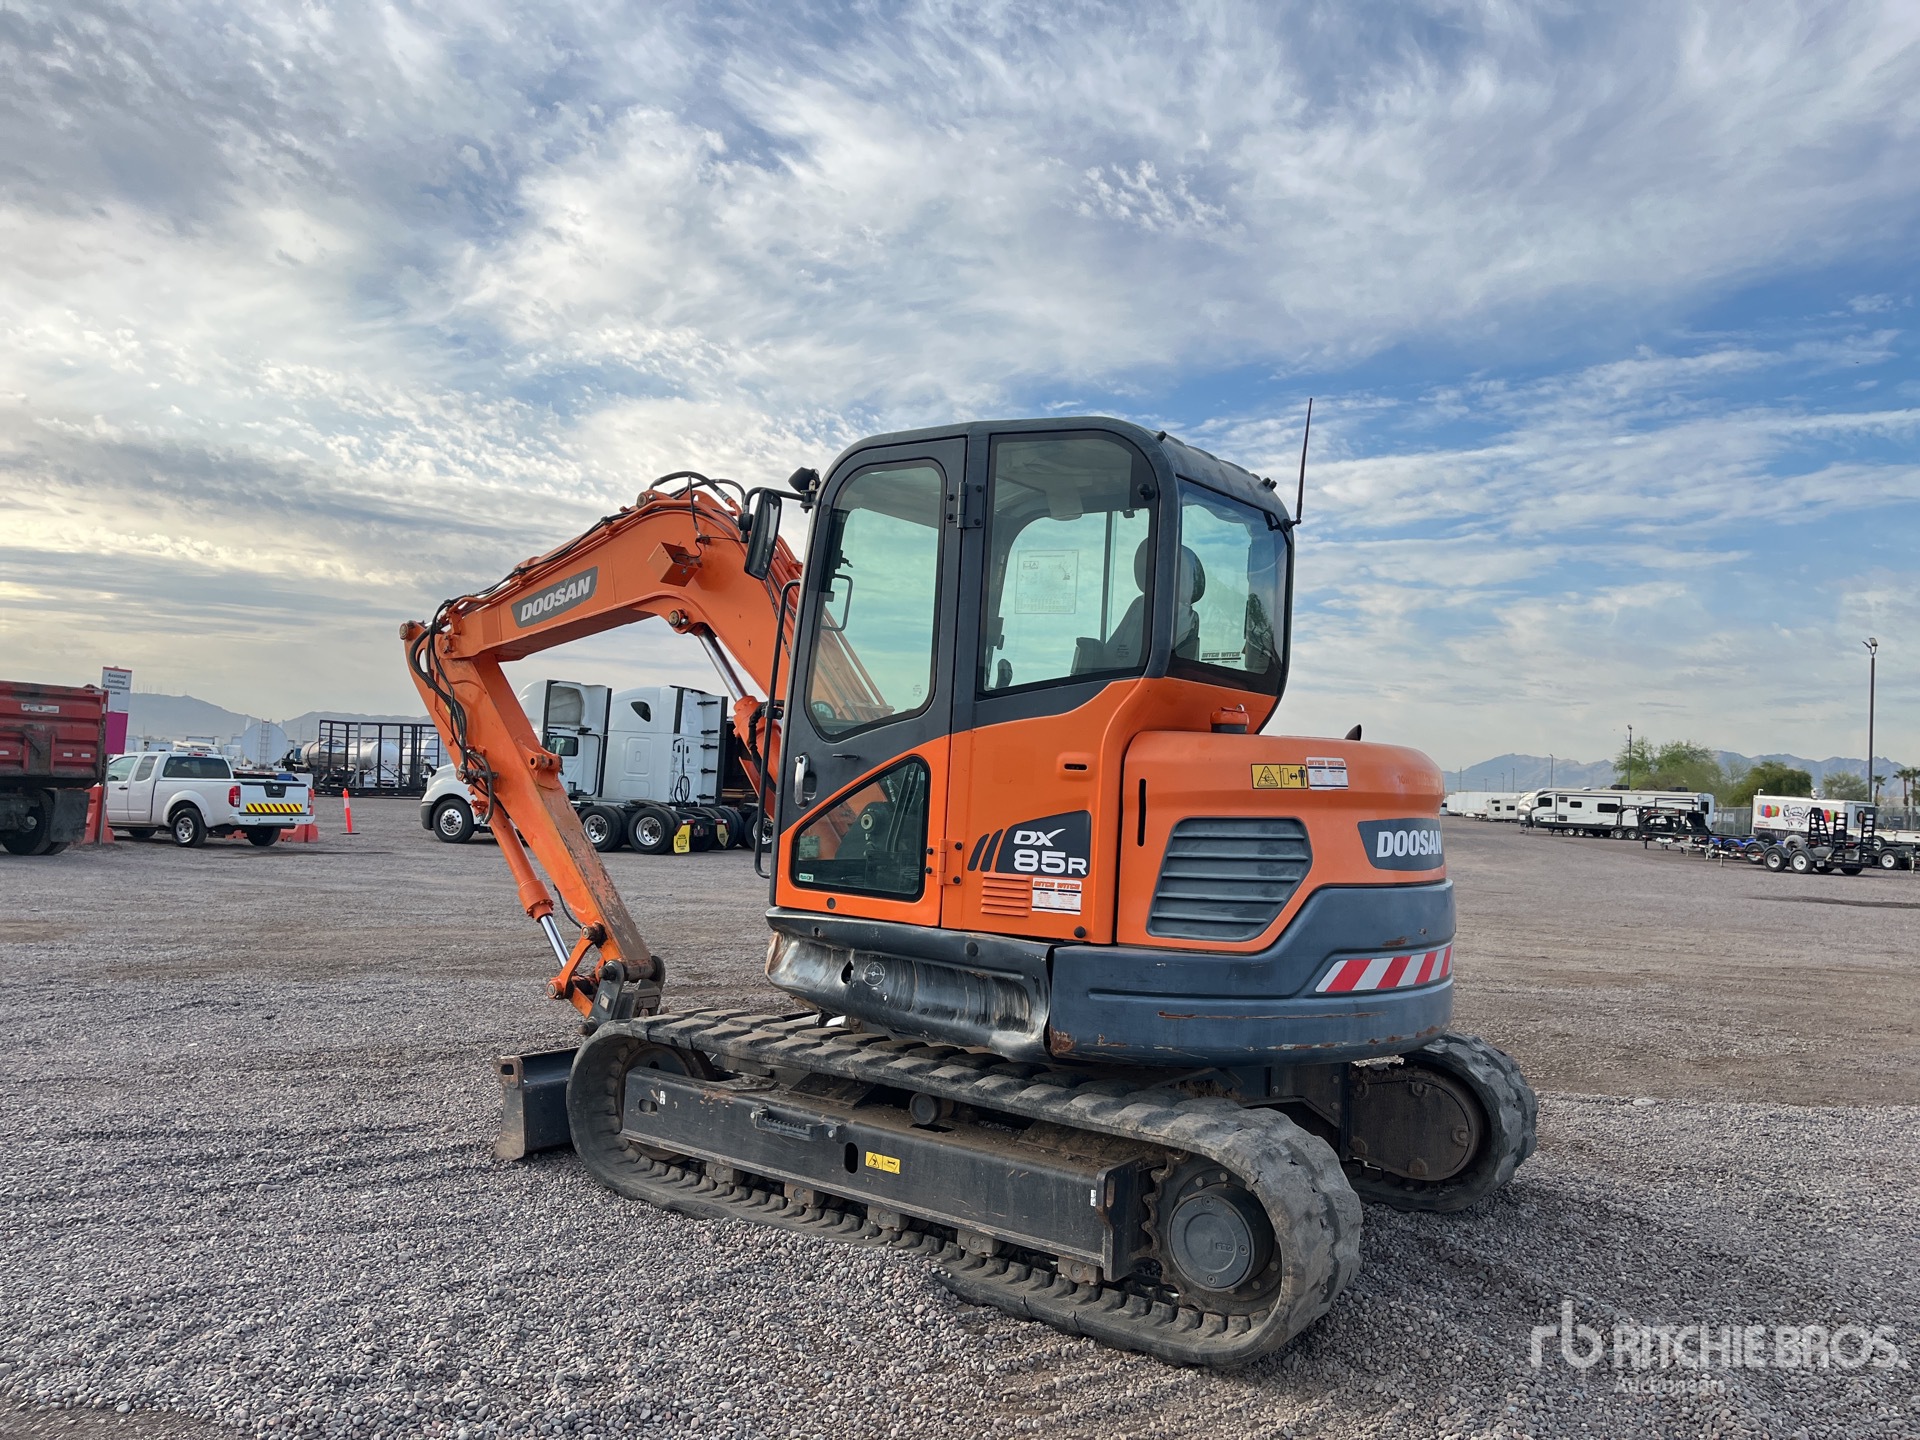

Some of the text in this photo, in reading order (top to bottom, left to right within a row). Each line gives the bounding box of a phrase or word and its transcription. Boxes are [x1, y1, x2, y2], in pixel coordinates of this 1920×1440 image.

[521, 576, 591, 622] DOOSAN
[1013, 828, 1066, 847] DX
[1376, 830, 1442, 858] DOOSAN
[1014, 849, 1087, 875] 85R
